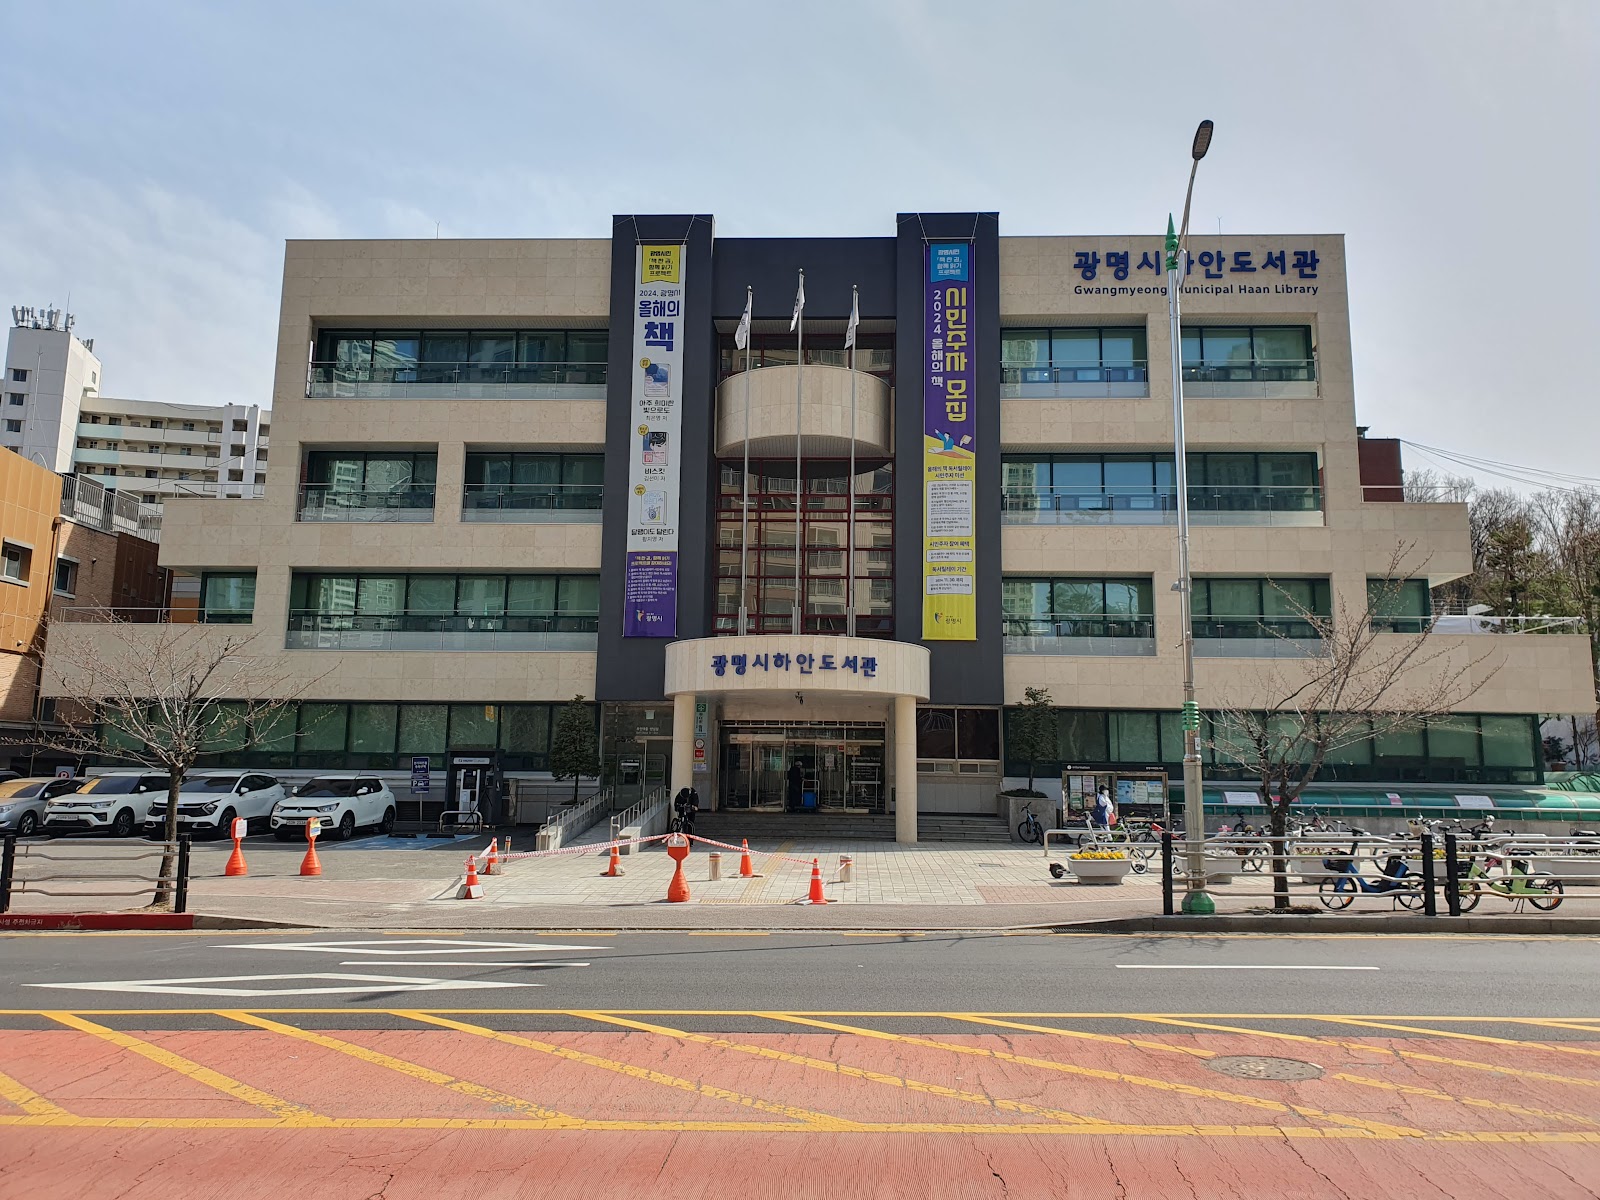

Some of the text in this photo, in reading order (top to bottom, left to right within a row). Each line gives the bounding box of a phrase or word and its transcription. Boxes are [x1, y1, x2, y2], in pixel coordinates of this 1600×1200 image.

[1074, 285, 1167, 296] Gwangmyeong
[1238, 285, 1270, 294] Haan
[1275, 284, 1319, 296] Library
[639, 300, 680, 317] 올해의
[644, 322, 674, 351] 책
[931, 338, 943, 372] 올해의
[946, 288, 967, 421] 시민주자 모집
[931, 376, 943, 387] 책
[711, 652, 878, 677] 광명시하안도서관
